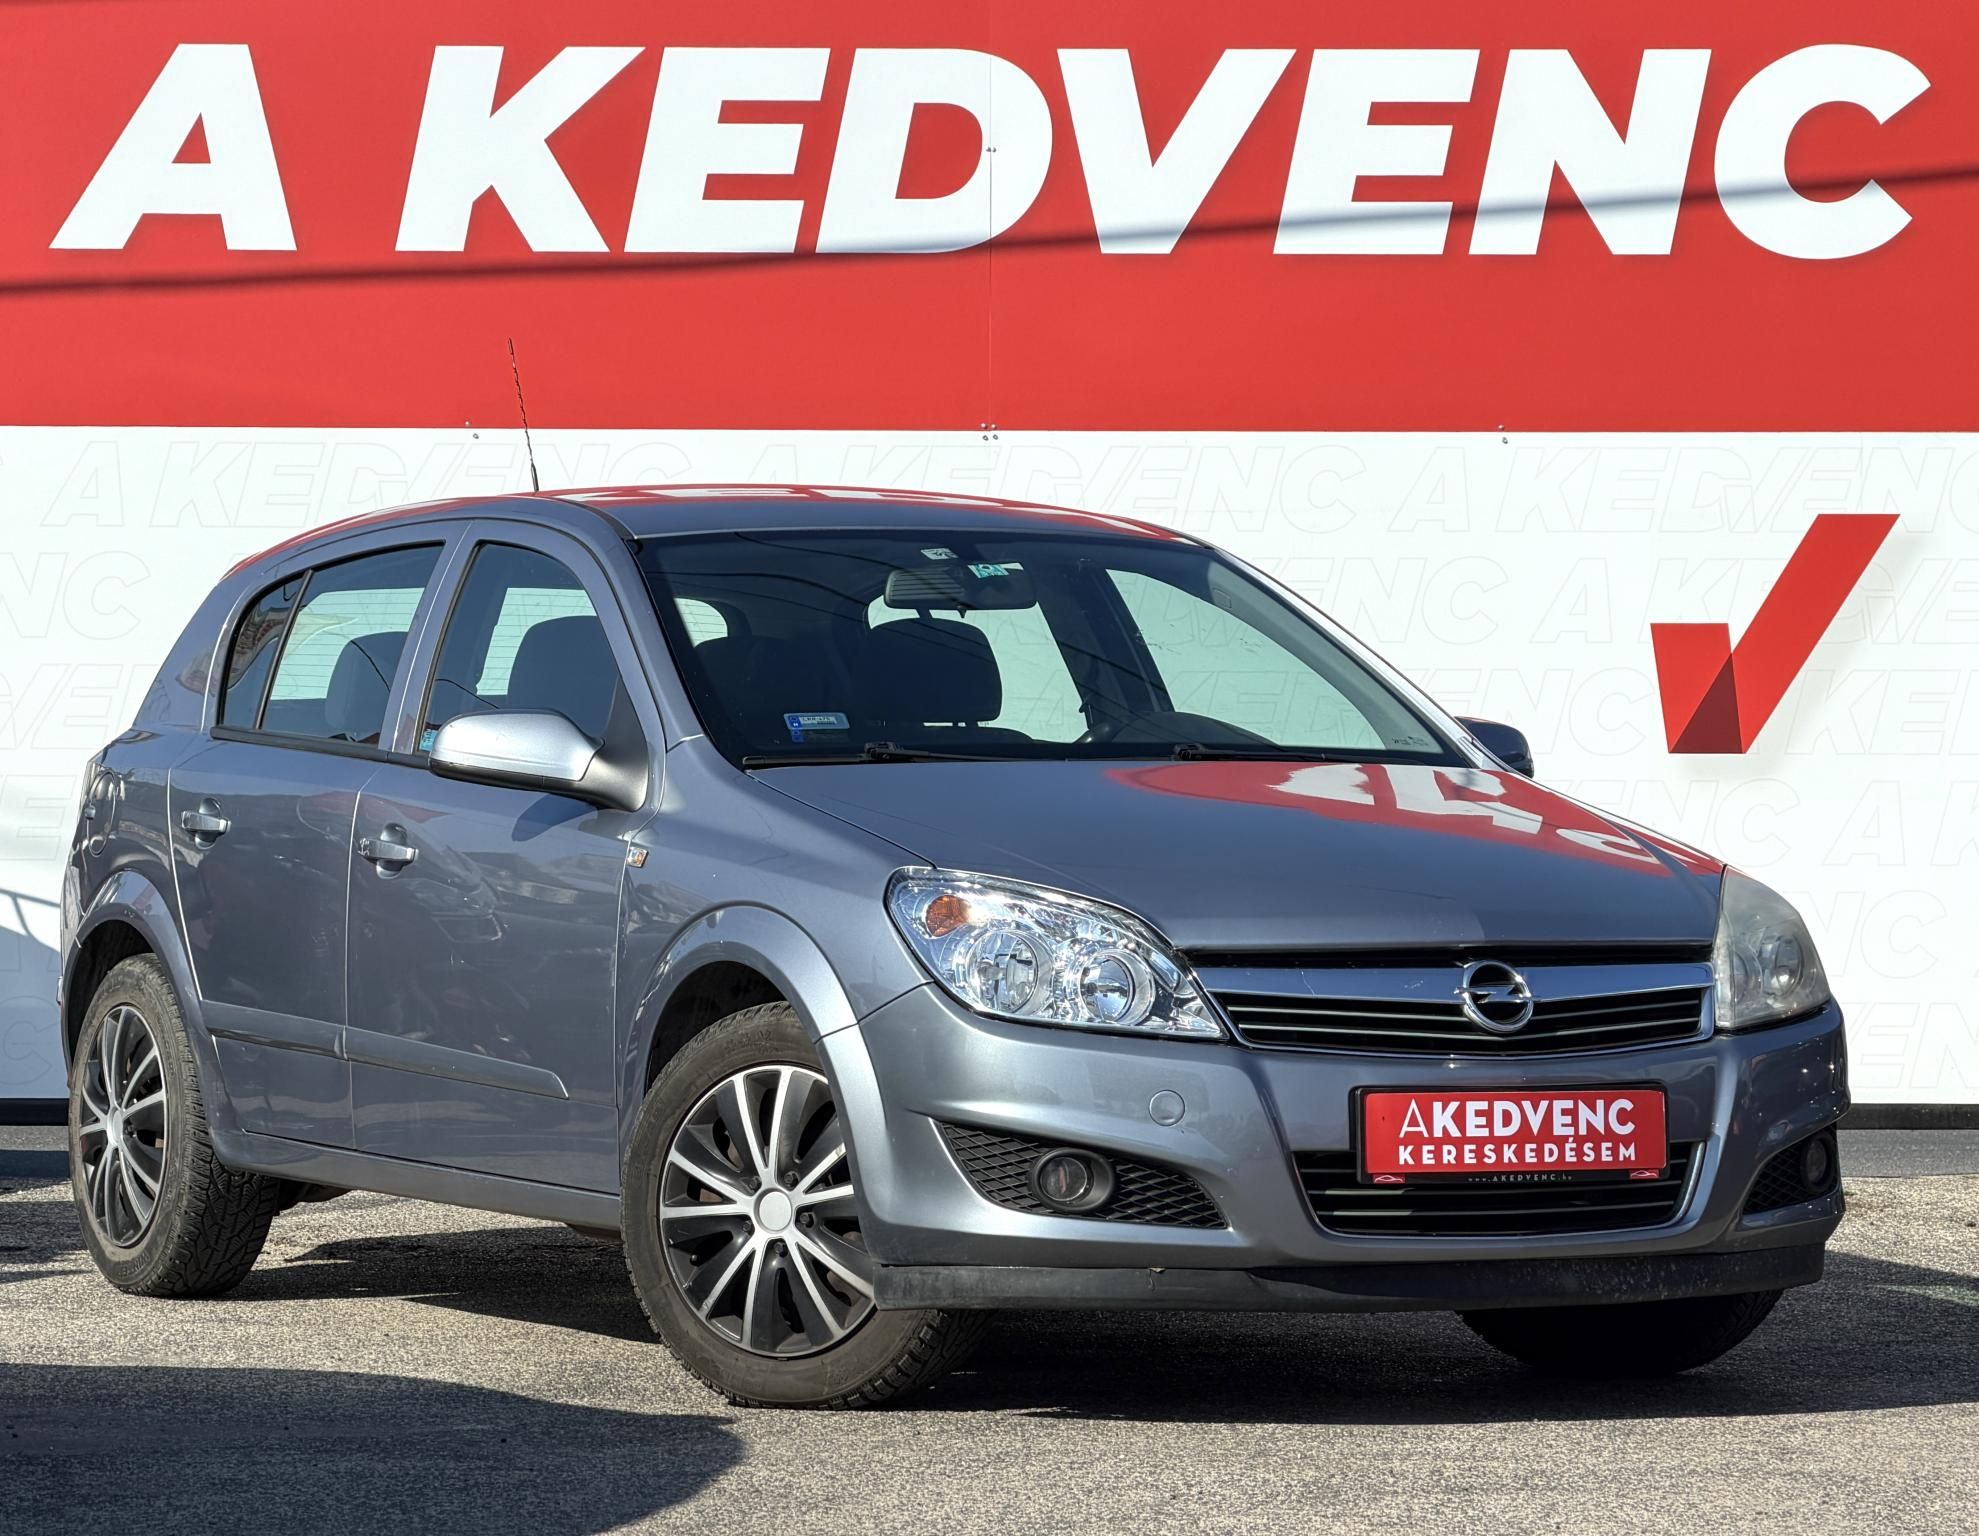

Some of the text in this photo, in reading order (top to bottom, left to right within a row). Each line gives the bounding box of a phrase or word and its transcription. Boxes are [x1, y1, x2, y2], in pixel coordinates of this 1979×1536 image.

[50, 43, 1932, 260] A KEDVENC
[1399, 1137, 1636, 1165] KERESKEDÉSEM
